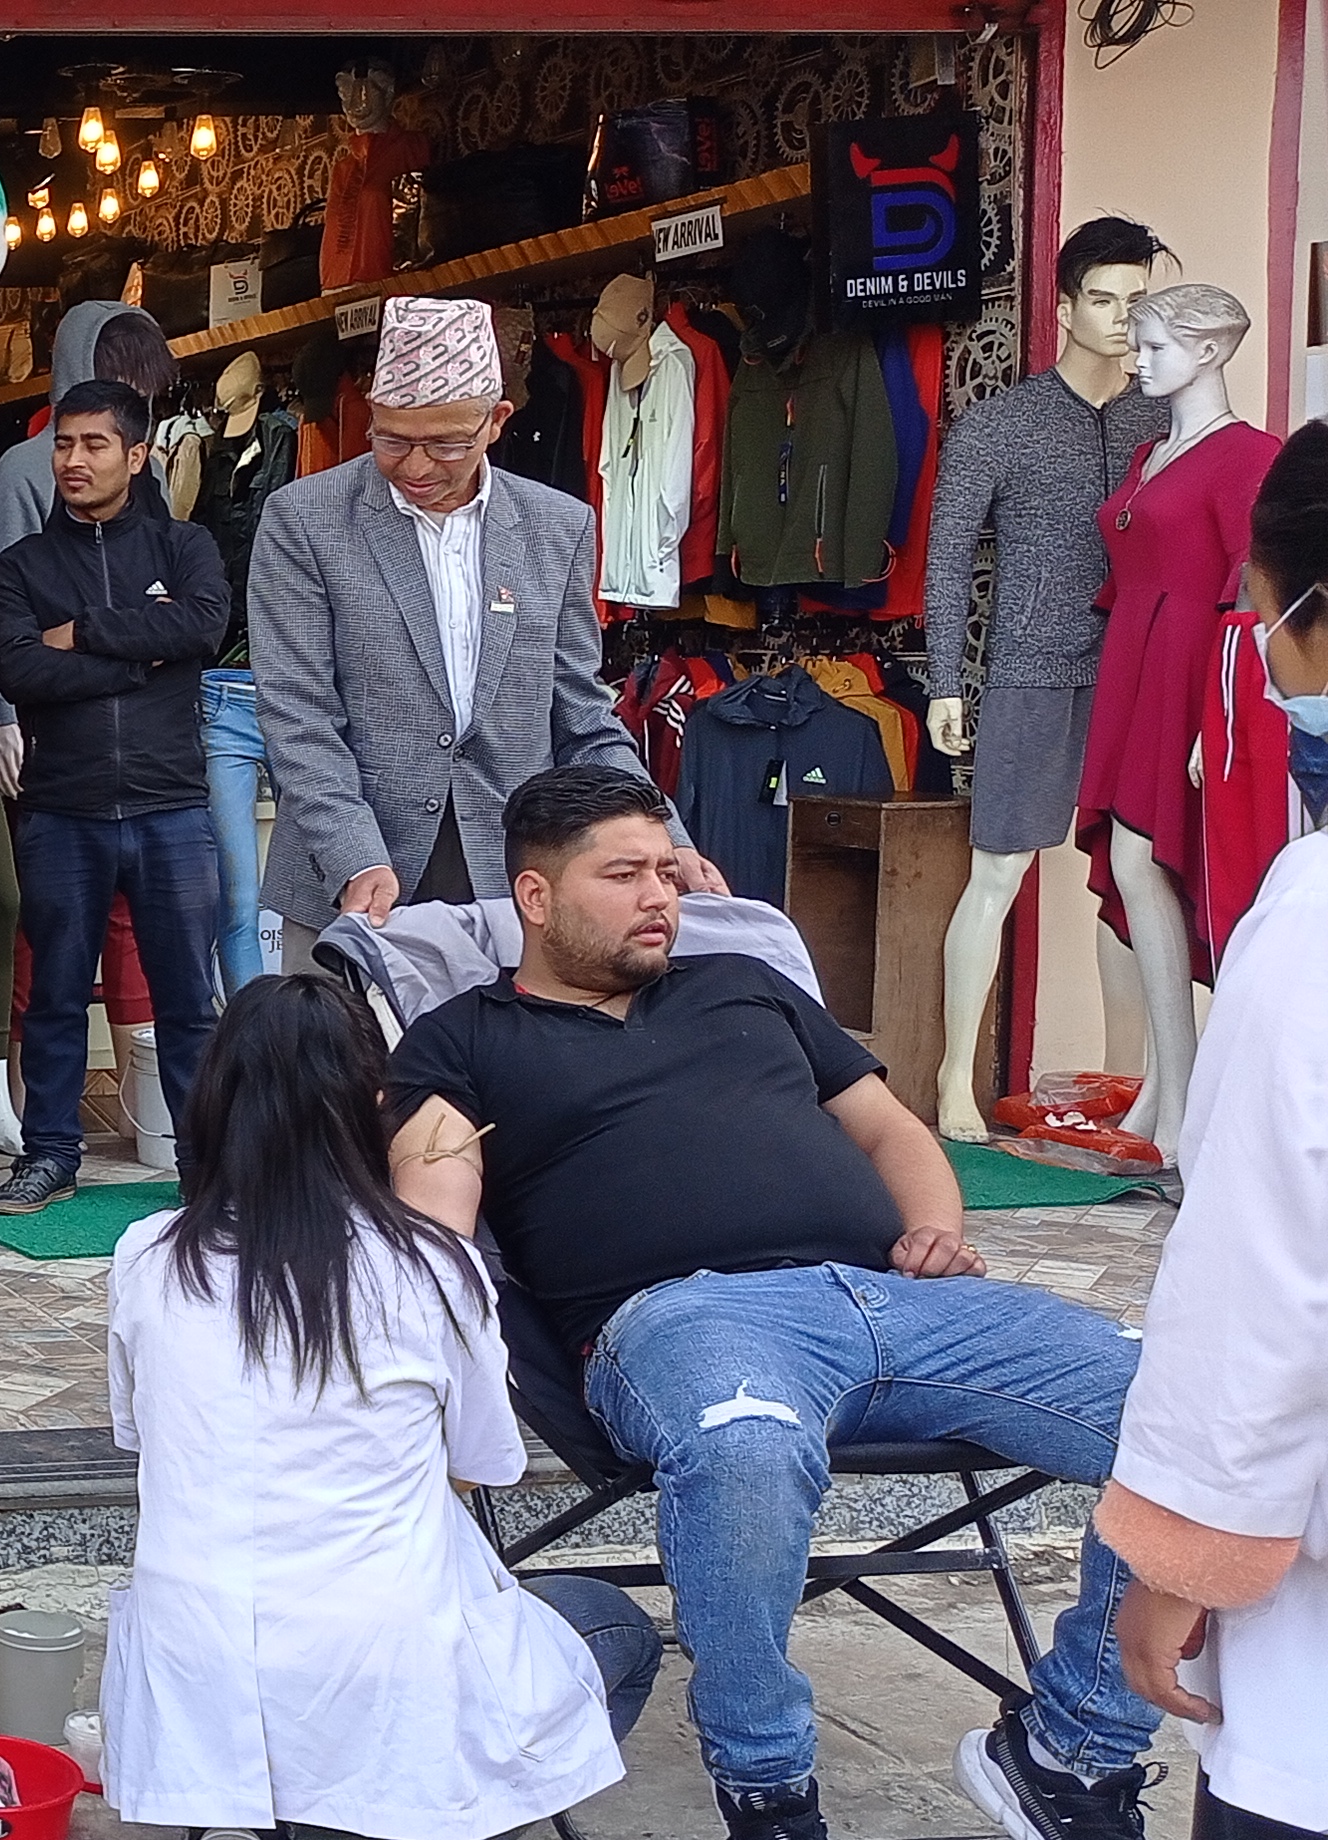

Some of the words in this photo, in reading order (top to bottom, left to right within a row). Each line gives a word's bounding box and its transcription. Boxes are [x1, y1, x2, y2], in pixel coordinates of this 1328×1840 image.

[672, 213, 719, 251] ARRIVAL
[846, 275, 893, 298] DENIM
[898, 274, 909, 292] &
[914, 269, 966, 292] DEVILS
